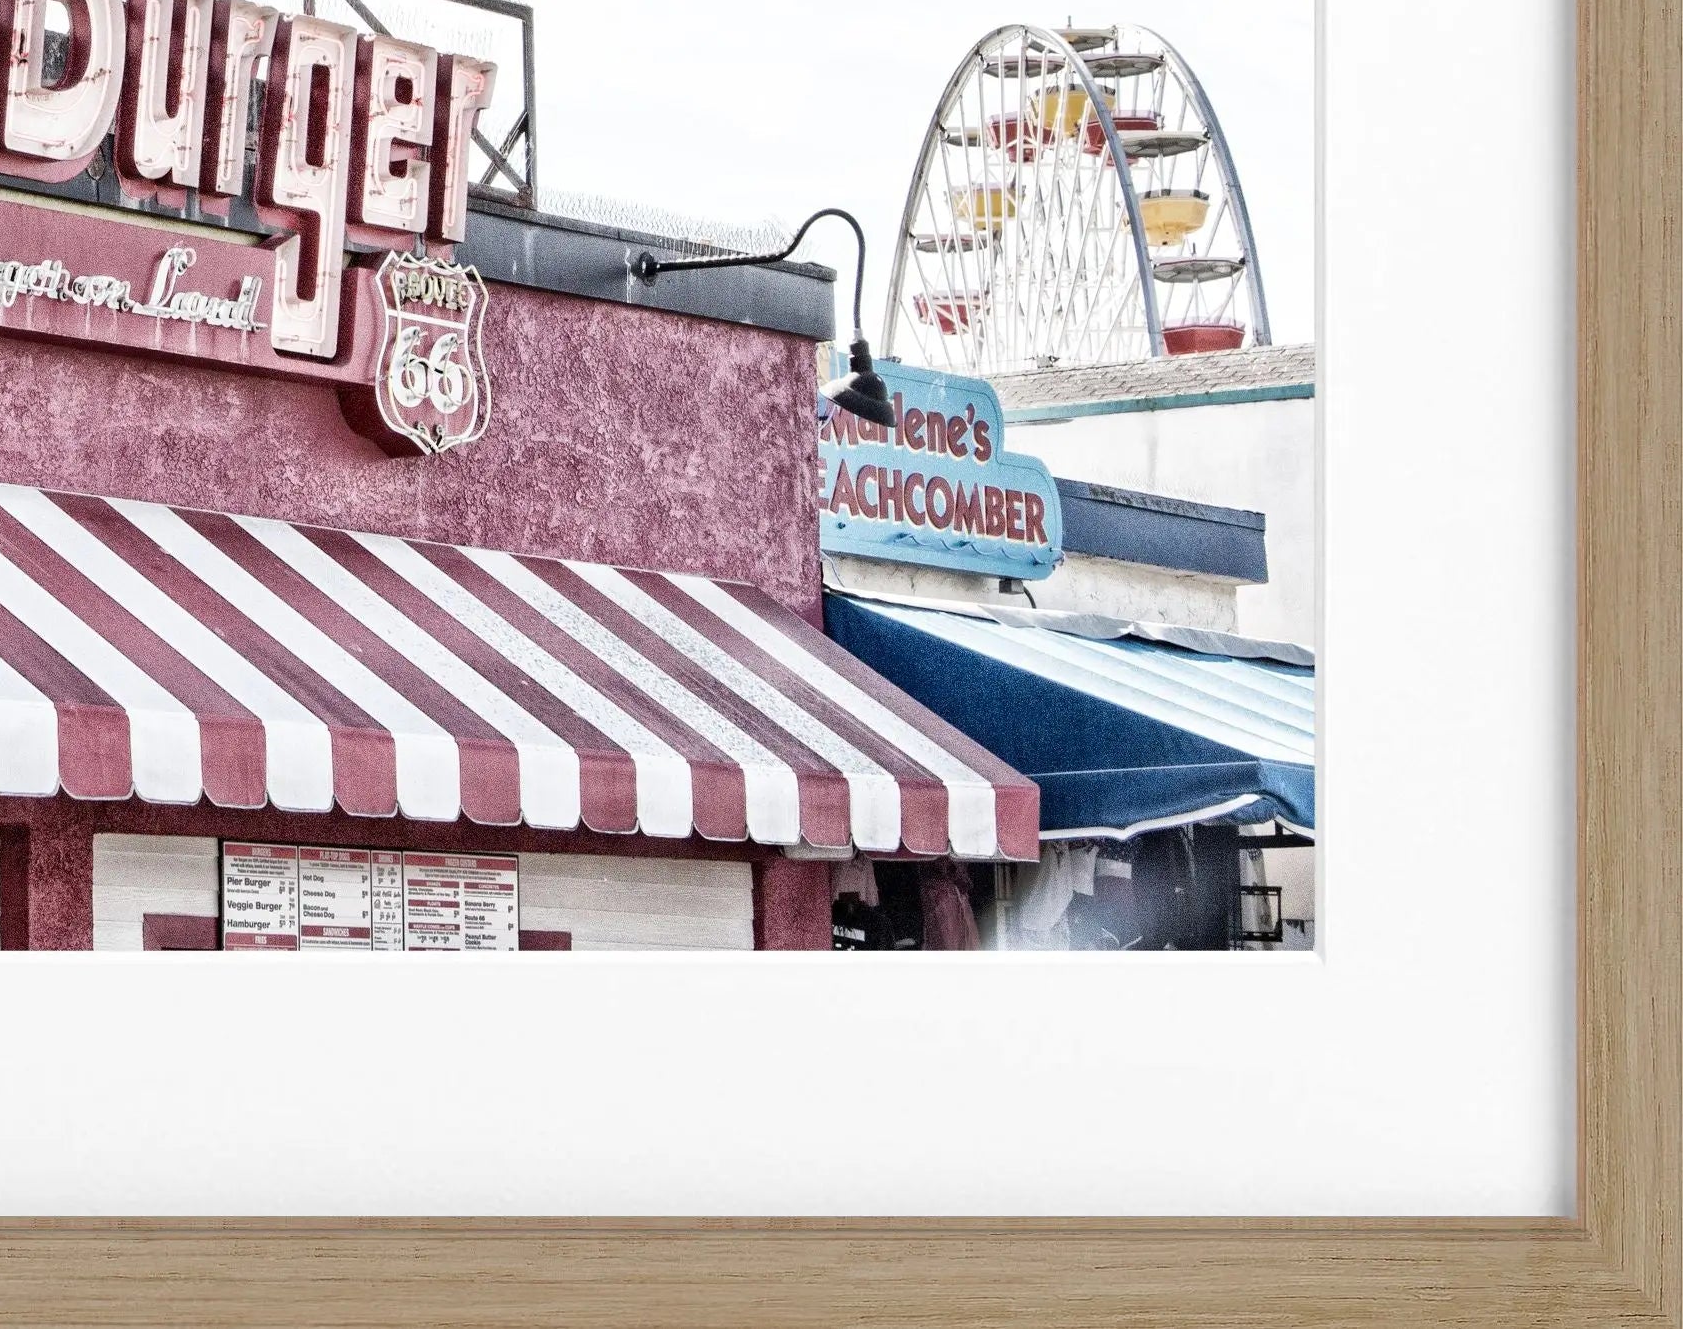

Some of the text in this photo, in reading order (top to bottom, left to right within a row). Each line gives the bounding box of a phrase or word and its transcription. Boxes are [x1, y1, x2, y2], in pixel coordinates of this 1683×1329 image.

[133, 247, 267, 333] Land
[392, 326, 472, 414] 66
[227, 877, 243, 886] Pier
[244, 878, 271, 888] Burger
[314, 875, 324, 883] Dog
[324, 891, 335, 899] Dog
[227, 900, 254, 910] Veggie
[255, 902, 283, 912] Burger
[324, 912, 335, 920] Dog
[227, 919, 270, 930] Hamburger
